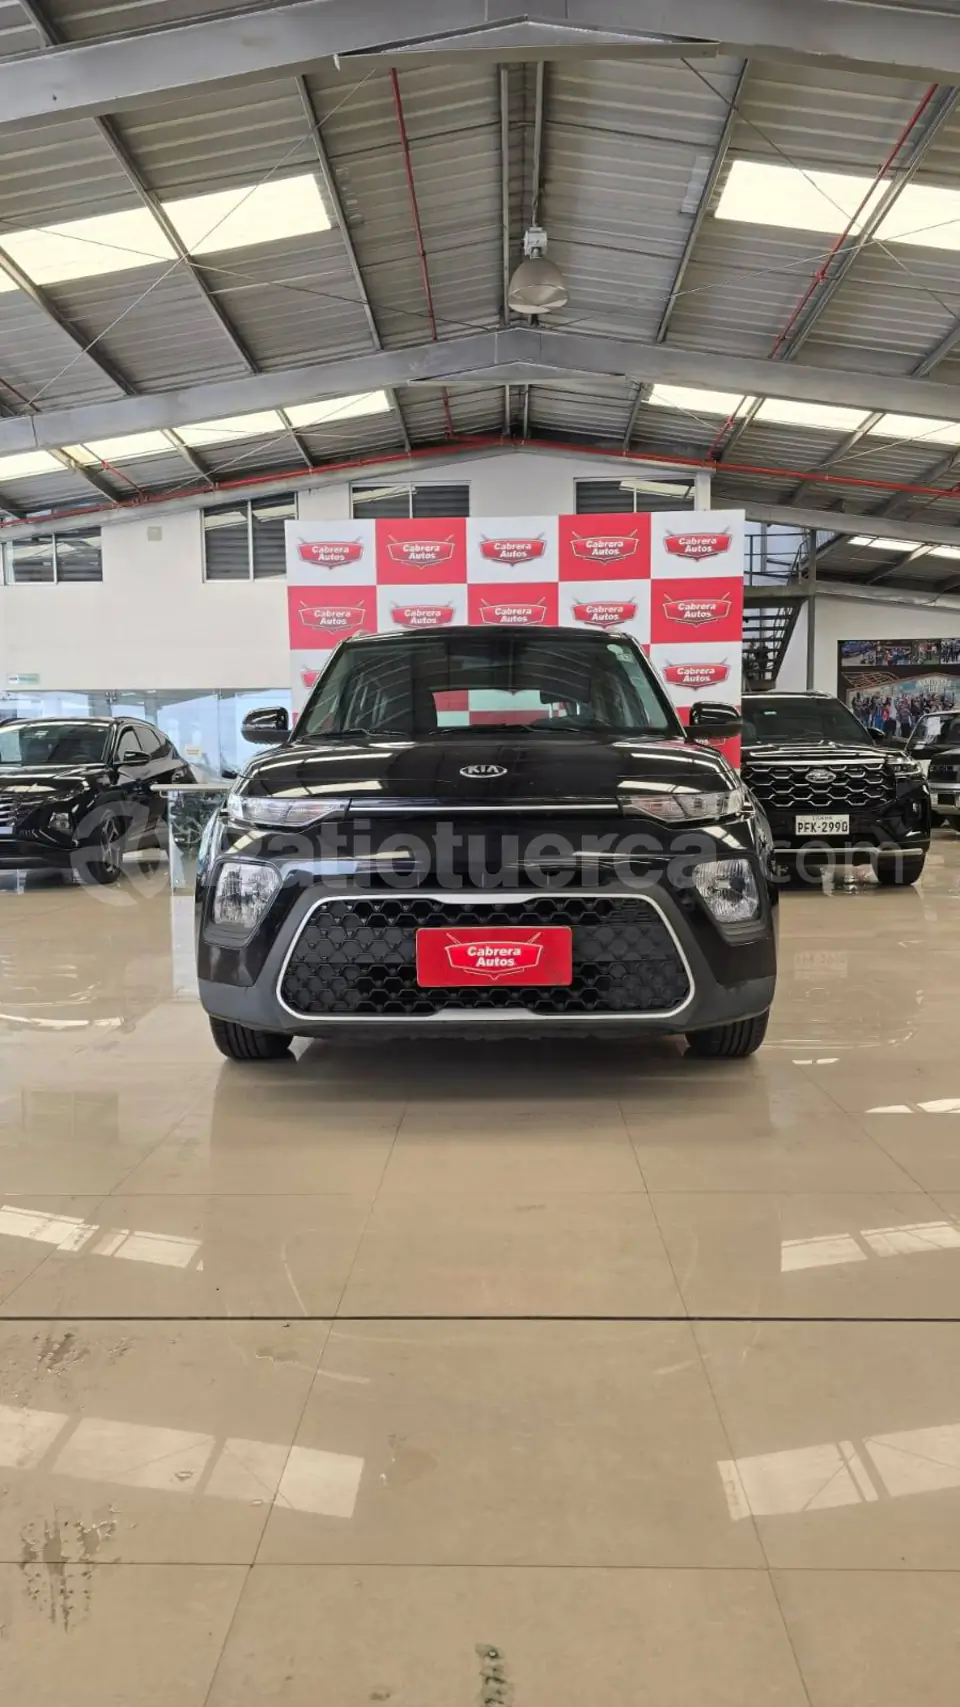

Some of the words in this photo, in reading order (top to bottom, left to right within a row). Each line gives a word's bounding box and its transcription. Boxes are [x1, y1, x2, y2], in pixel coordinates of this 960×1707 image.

[586, 540, 624, 548] Cabrera
[678, 537, 717, 545] Cabrera
[312, 545, 349, 554] Cabrera
[403, 544, 440, 552] Cabrera
[494, 542, 532, 550] Cabrera
[409, 552, 436, 560] Autos
[500, 550, 527, 558] Autos
[592, 548, 619, 556] Autos
[318, 553, 345, 561] Autos
[495, 607, 532, 615] Cabrera
[586, 605, 624, 613] Cabrera
[678, 603, 717, 611] Cabrera
[314, 609, 351, 618] Cabrera
[404, 609, 441, 617] Cabrera
[592, 613, 619, 621] Autos
[320, 617, 346, 625] Autos
[677, 667, 715, 675] Cabrera
[683, 675, 711, 683] Autos
[467, 946, 521, 957] Cabrera
[476, 957, 515, 967] Autos
